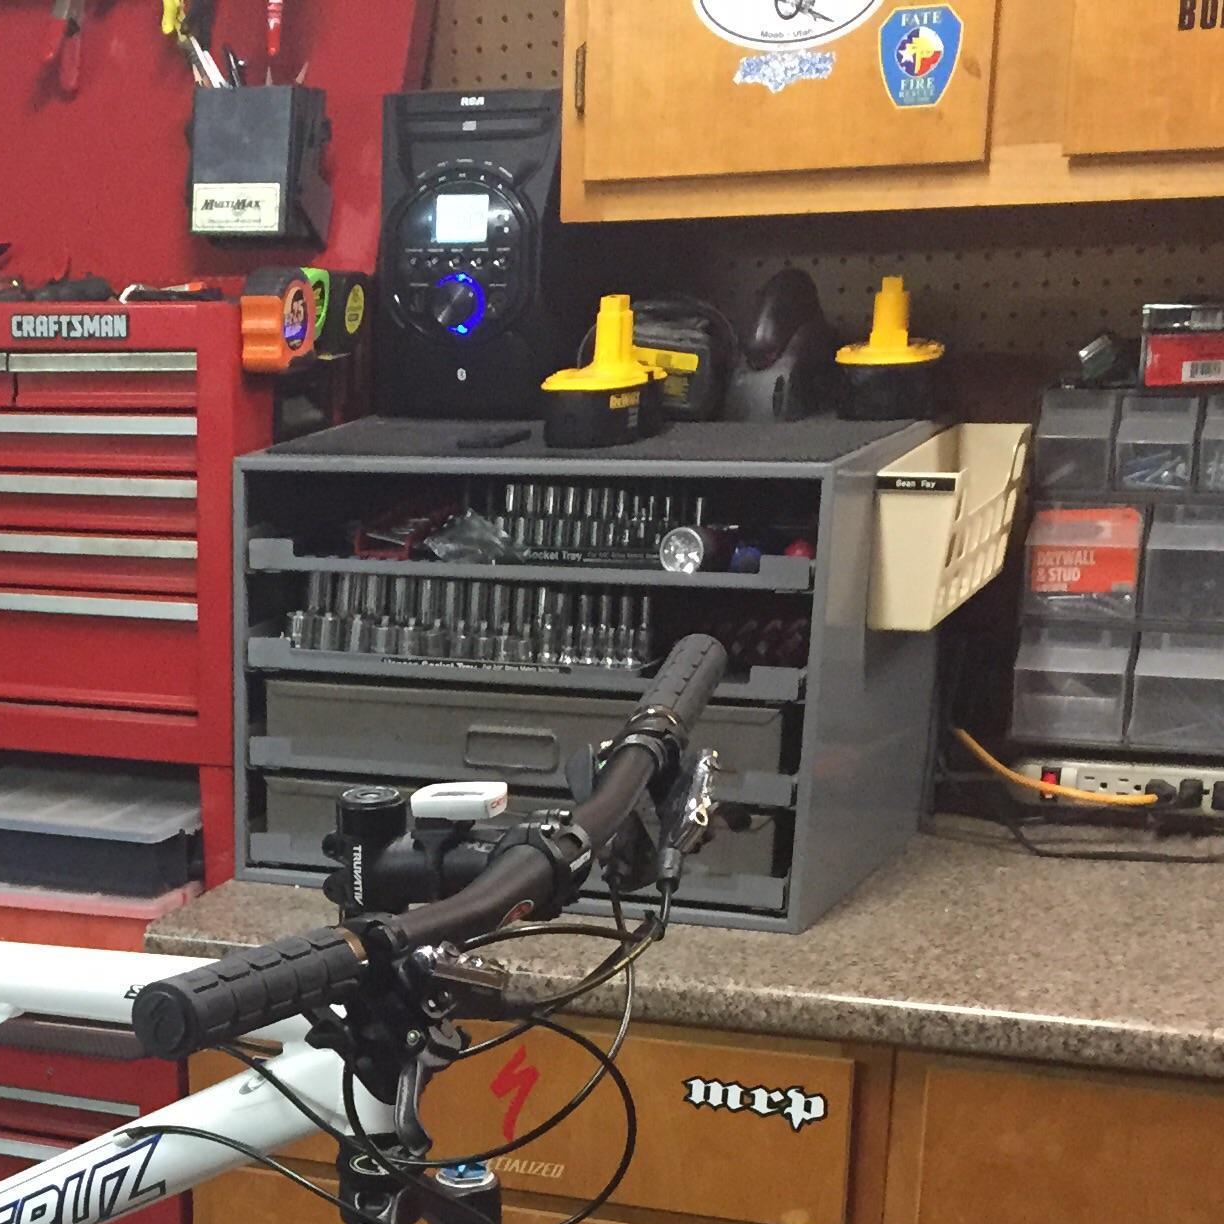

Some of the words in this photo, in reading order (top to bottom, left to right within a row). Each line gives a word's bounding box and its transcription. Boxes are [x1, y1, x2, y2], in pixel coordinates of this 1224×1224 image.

[901, 11, 942, 27] FATE
[900, 77, 935, 91] FIRE
[11, 314, 127, 338] CRAFTSMAN
[920, 479, 936, 489] Fay
[1048, 567, 1081, 582] STUD
[683, 1077, 826, 1131] mrp
[494, 1156, 566, 1178] CIALIZED
